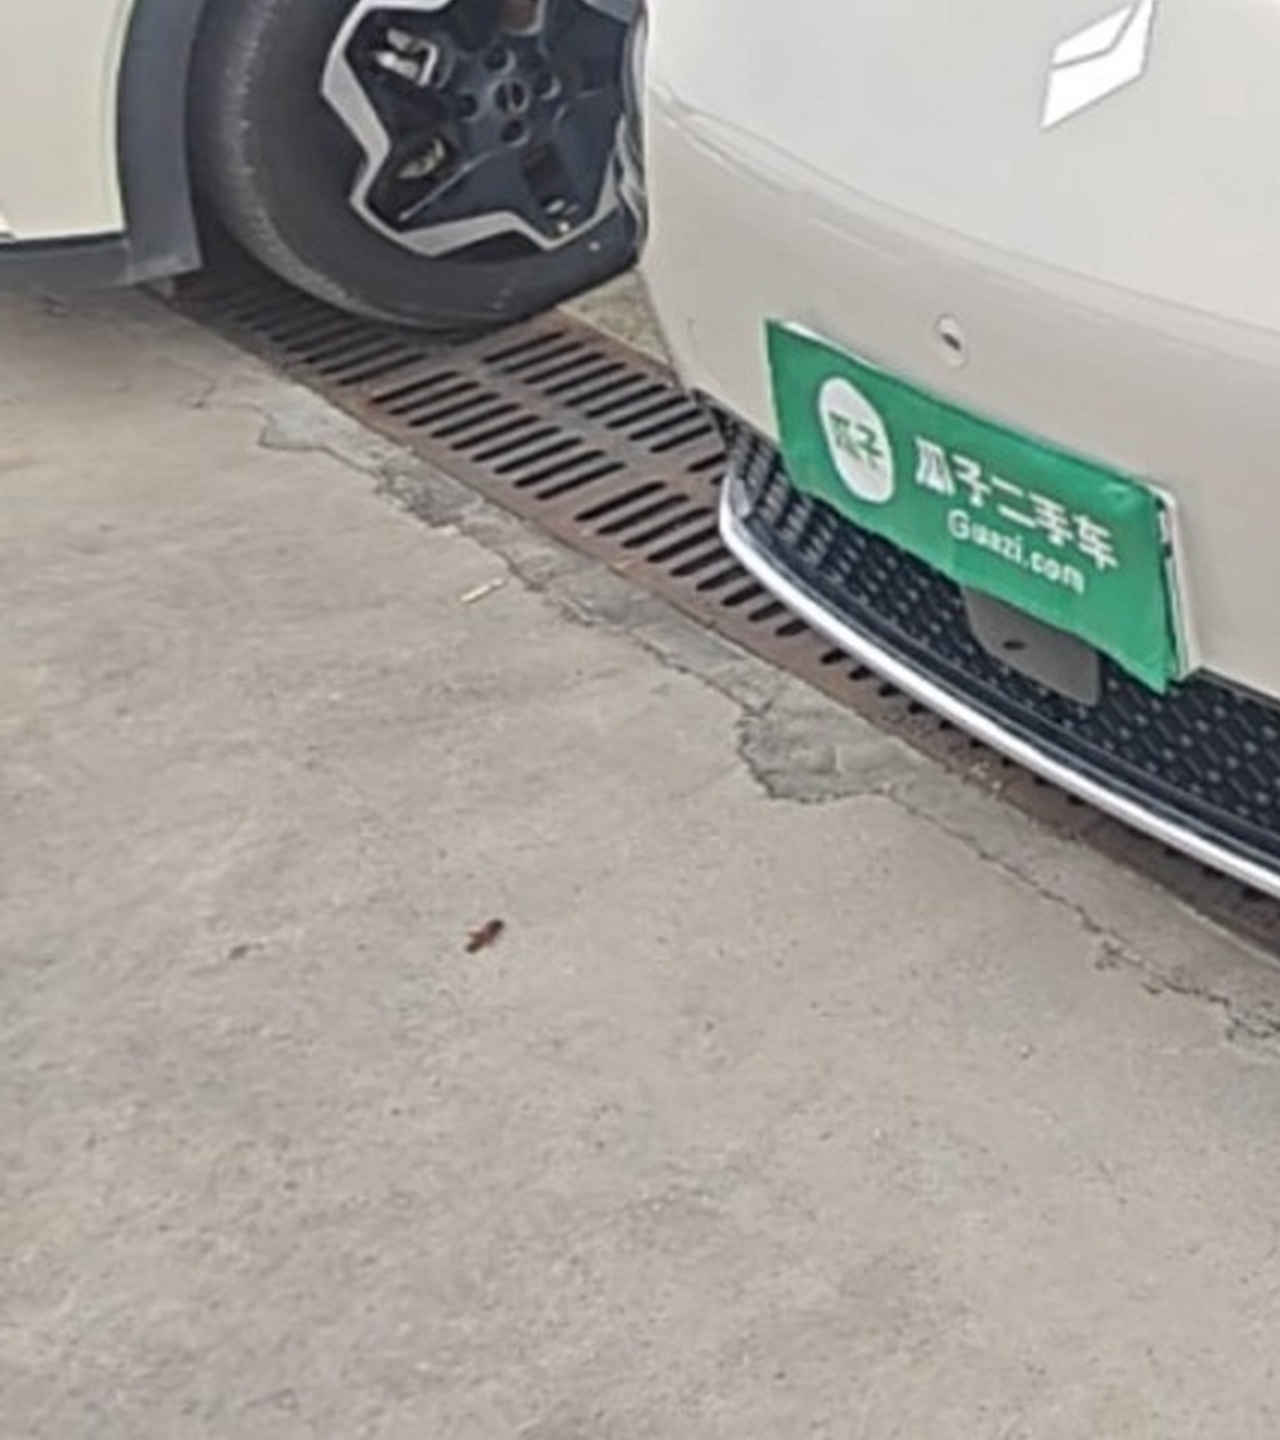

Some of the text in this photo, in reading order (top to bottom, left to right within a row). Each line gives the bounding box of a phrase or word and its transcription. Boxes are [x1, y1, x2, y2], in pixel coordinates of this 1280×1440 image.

[914, 434, 1119, 570] 瓜子二手车
[946, 509, 1085, 593] Guazi.com
